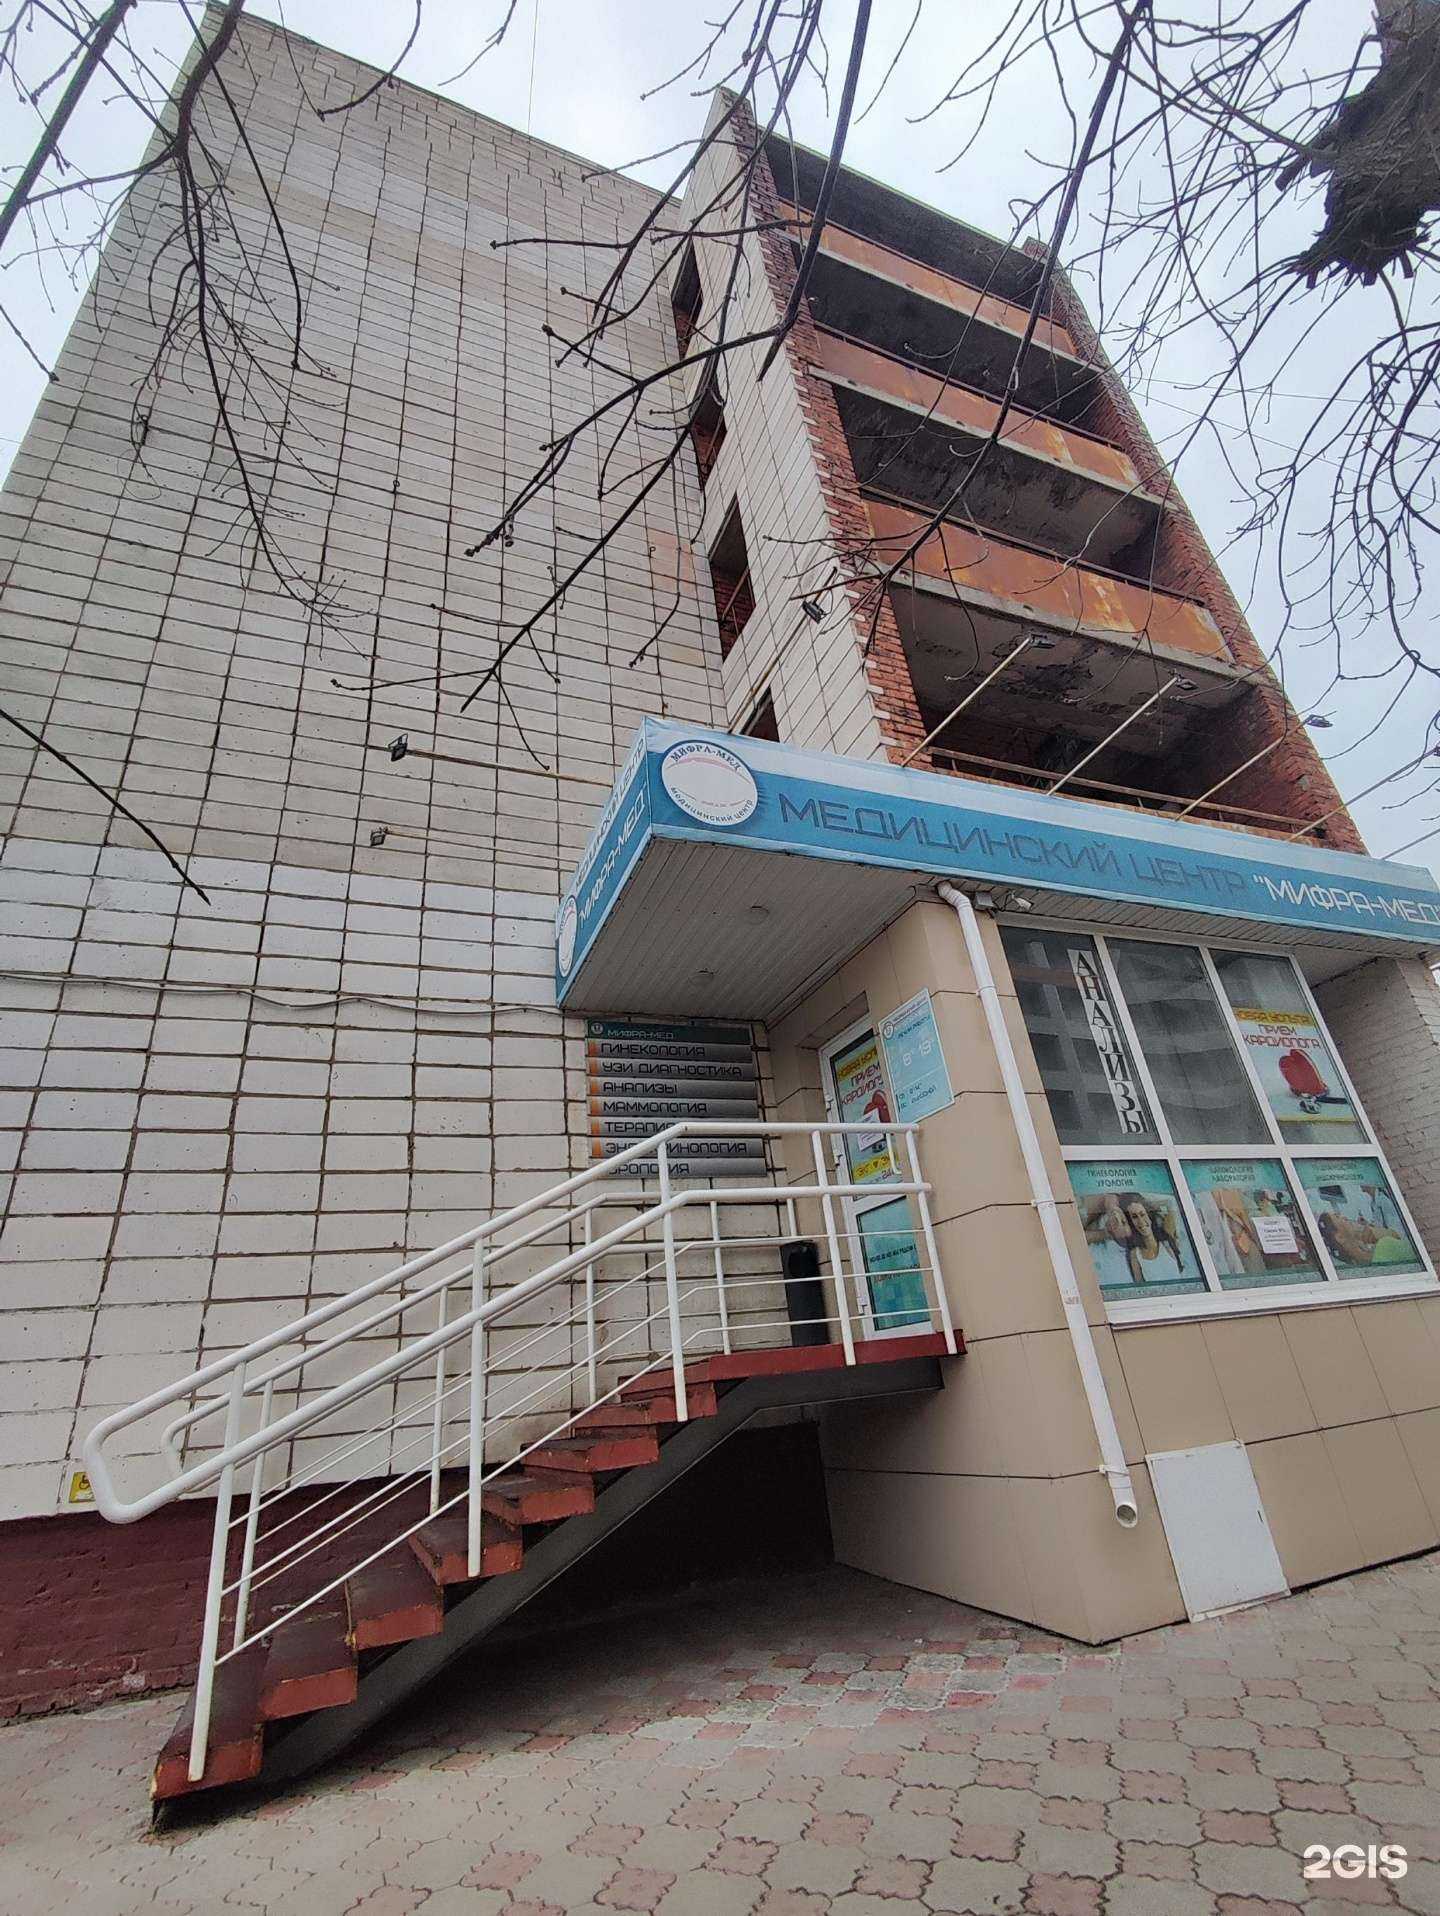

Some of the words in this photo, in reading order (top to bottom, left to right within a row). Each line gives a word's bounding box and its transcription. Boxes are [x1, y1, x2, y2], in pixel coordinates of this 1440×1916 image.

[670, 744, 742, 773] МИФРА-МЕД
[778, 792, 1122, 877] МЕДИЦИНСКИЙ
[1127, 852, 1246, 894] ЦЕНТР
[1253, 873, 1440, 926] "МИФРА-МЕД"
[607, 1030, 674, 1040] МИФРА-МЕД
[1077, 951, 1149, 1134] АНАЛИЗЫ
[601, 1043, 705, 1057] ГИНЕКОЛОГИЯ
[602, 1062, 634, 1073] УЗИ
[638, 1063, 742, 1077] ДИАГНОСТИКА
[603, 1081, 678, 1094] АНАЛИЗЫ
[603, 1101, 707, 1113] МАММОЛОГИЯ
[605, 1142, 747, 1154] ЭНИНОЛОГИЯ
[608, 1162, 690, 1175] РОЛОИЯ
[1087, 1168, 1137, 1177] ГИНЕКОЛОГИЯ
[1096, 1179, 1134, 1187] УРОЛОГИЯ
